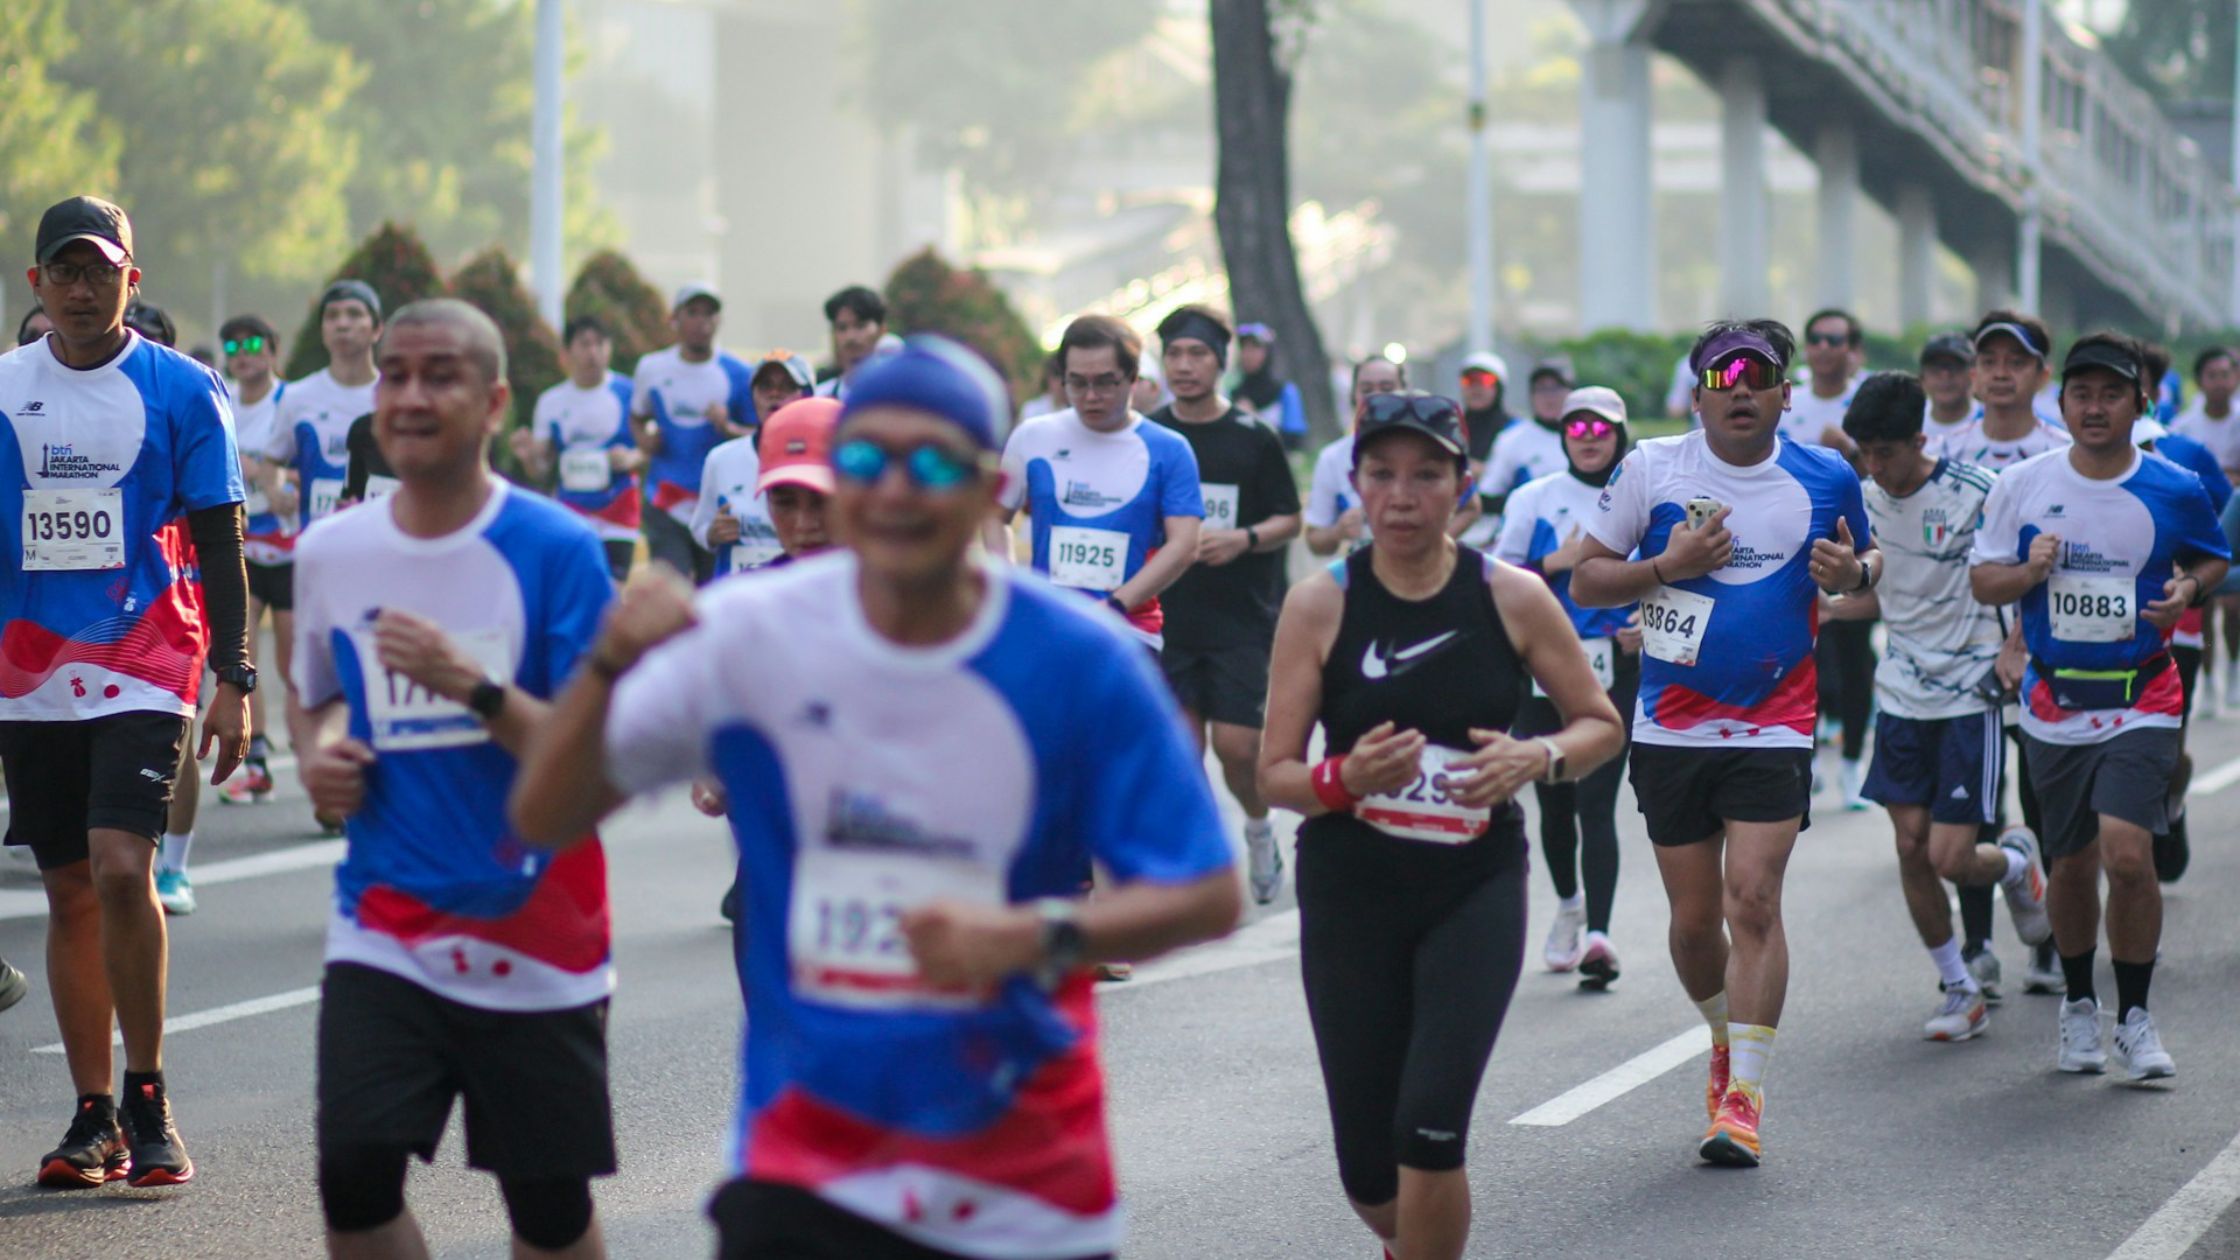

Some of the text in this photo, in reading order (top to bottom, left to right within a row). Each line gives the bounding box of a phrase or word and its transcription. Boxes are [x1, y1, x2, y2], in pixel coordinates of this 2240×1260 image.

[1205, 498, 1229, 518] 96
[28, 511, 111, 540] 13590
[1059, 543, 1114, 567] 11925
[2054, 592, 2127, 618] 10883
[1641, 602, 1696, 638] 13864
